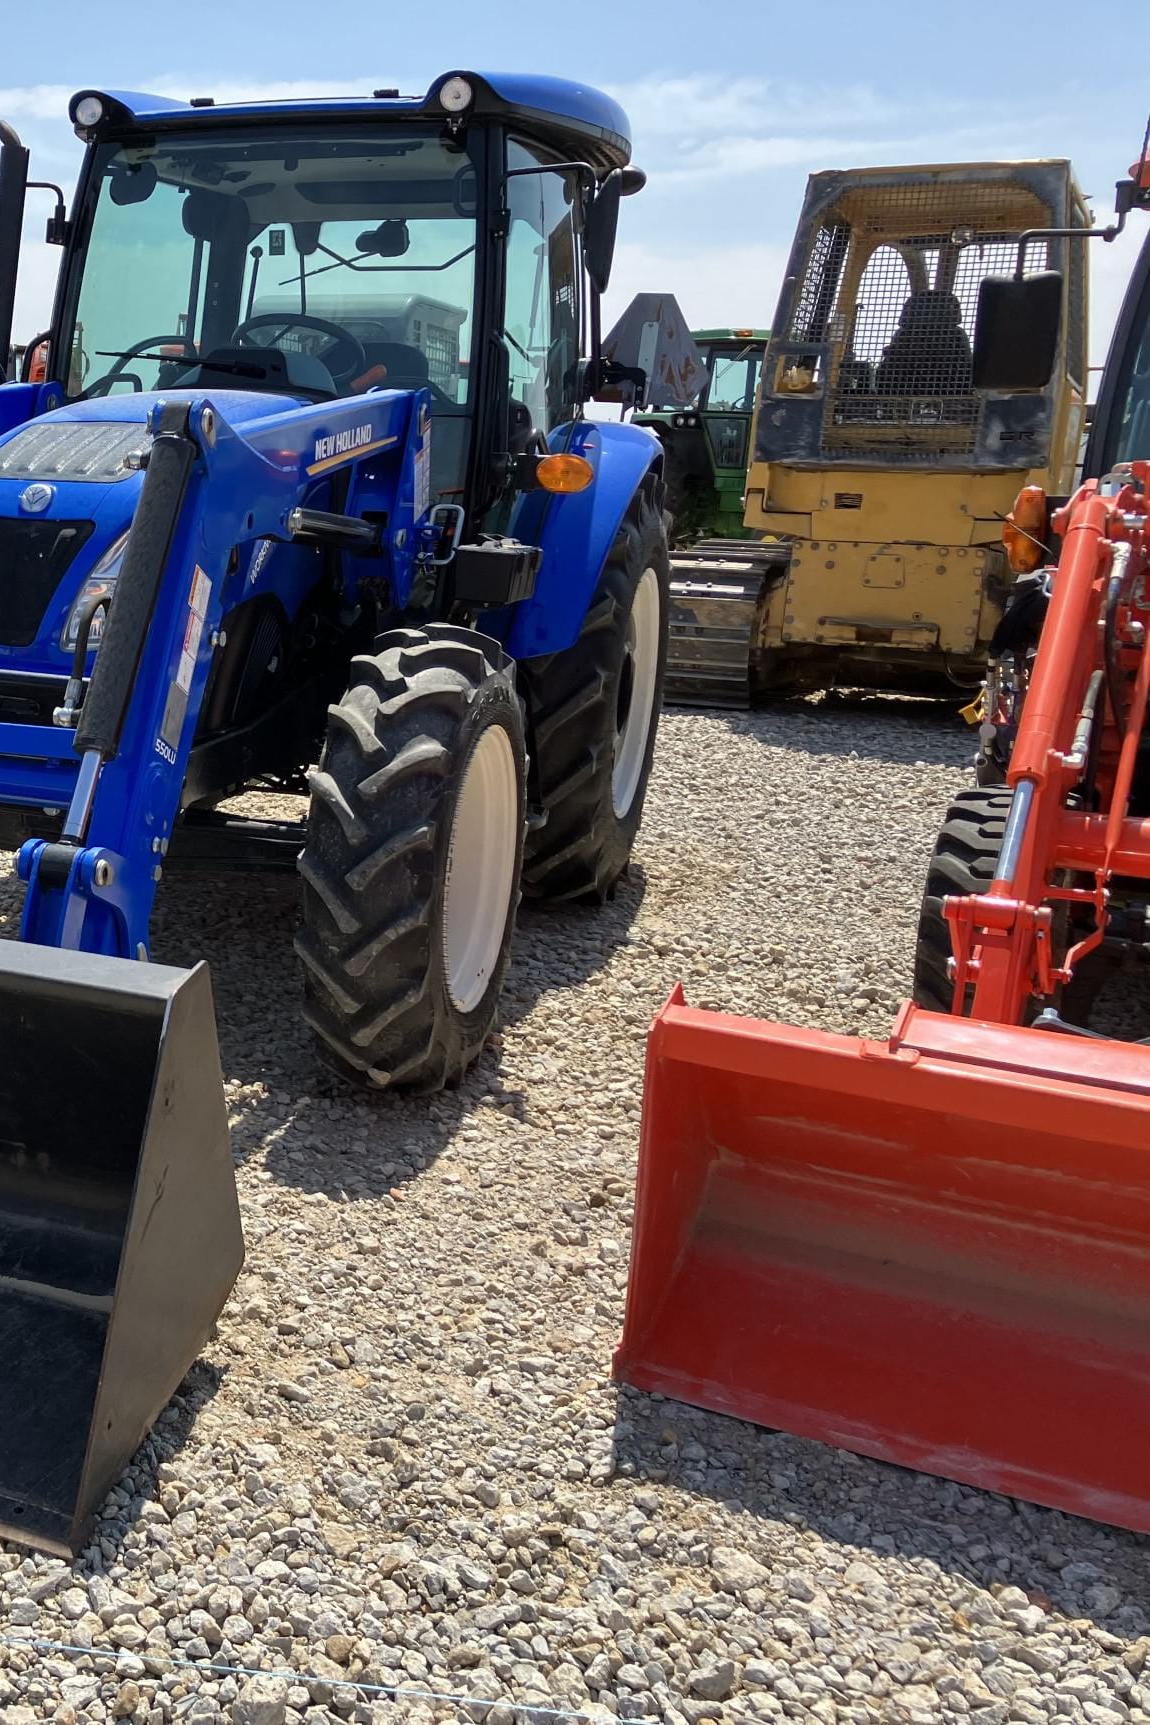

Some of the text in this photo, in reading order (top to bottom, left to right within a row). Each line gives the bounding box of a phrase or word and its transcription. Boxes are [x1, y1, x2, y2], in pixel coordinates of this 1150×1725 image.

[315, 423, 372, 461] NEW HOLLAND
[155, 738, 177, 765] 550LU
